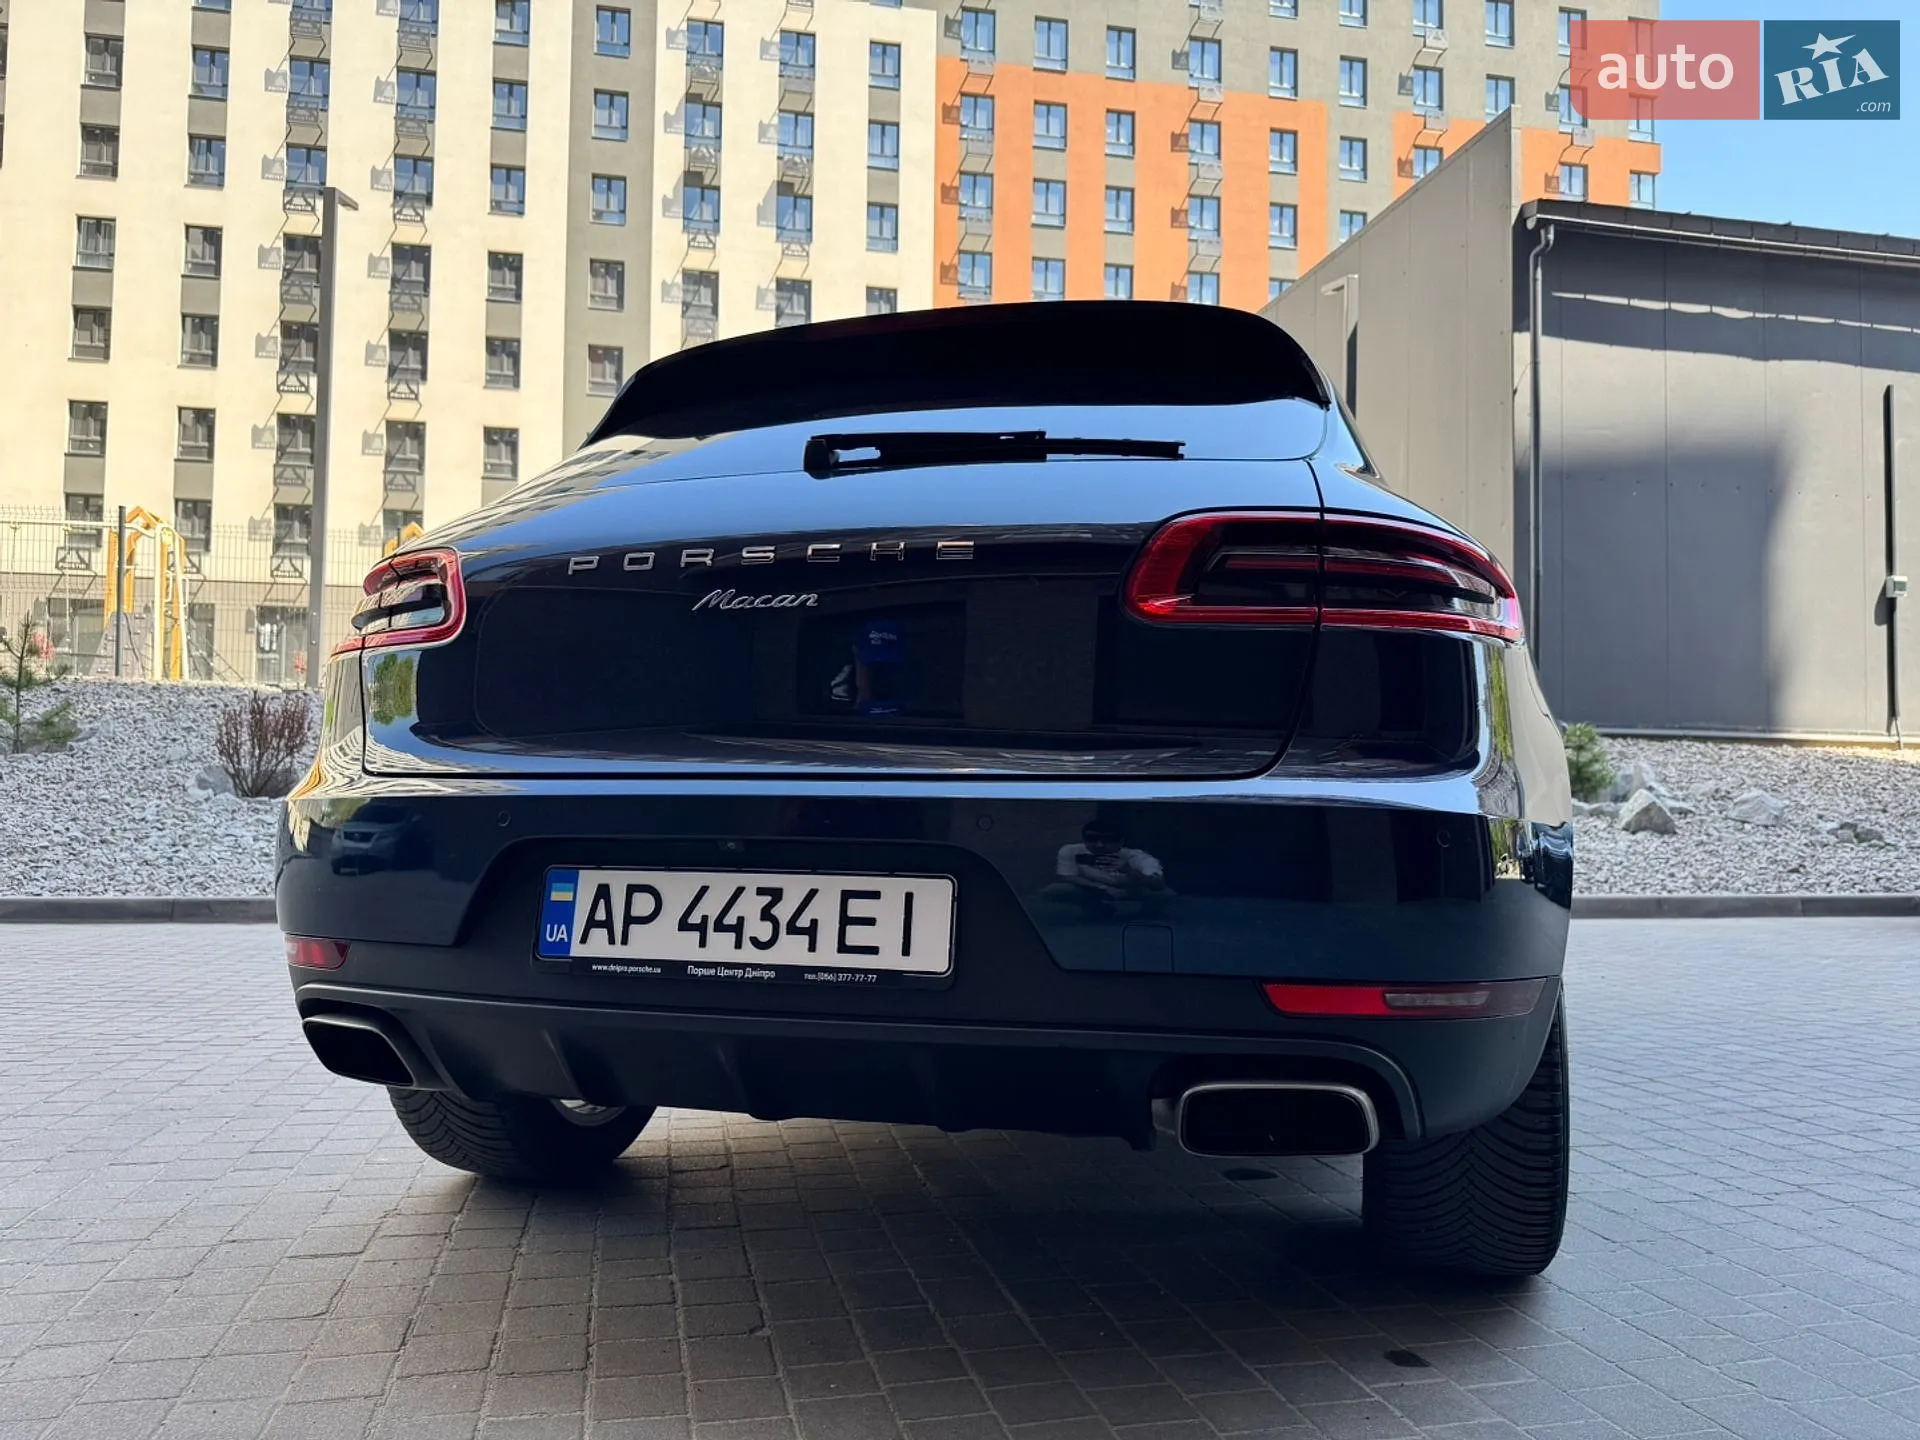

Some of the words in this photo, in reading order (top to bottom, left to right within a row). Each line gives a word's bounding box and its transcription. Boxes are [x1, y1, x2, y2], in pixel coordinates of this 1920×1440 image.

[568, 540, 975, 576] PORSCHE
[691, 588, 818, 611] Macan
[578, 883, 663, 946] AP
[677, 885, 820, 953] 4434
[836, 889, 914, 957] EI
[546, 924, 568, 943] UA
[687, 965, 716, 977] Порше
[717, 967, 743, 979] Центр
[744, 968, 776, 981] Дніпро
[837, 973, 878, 983] 377-77-77
